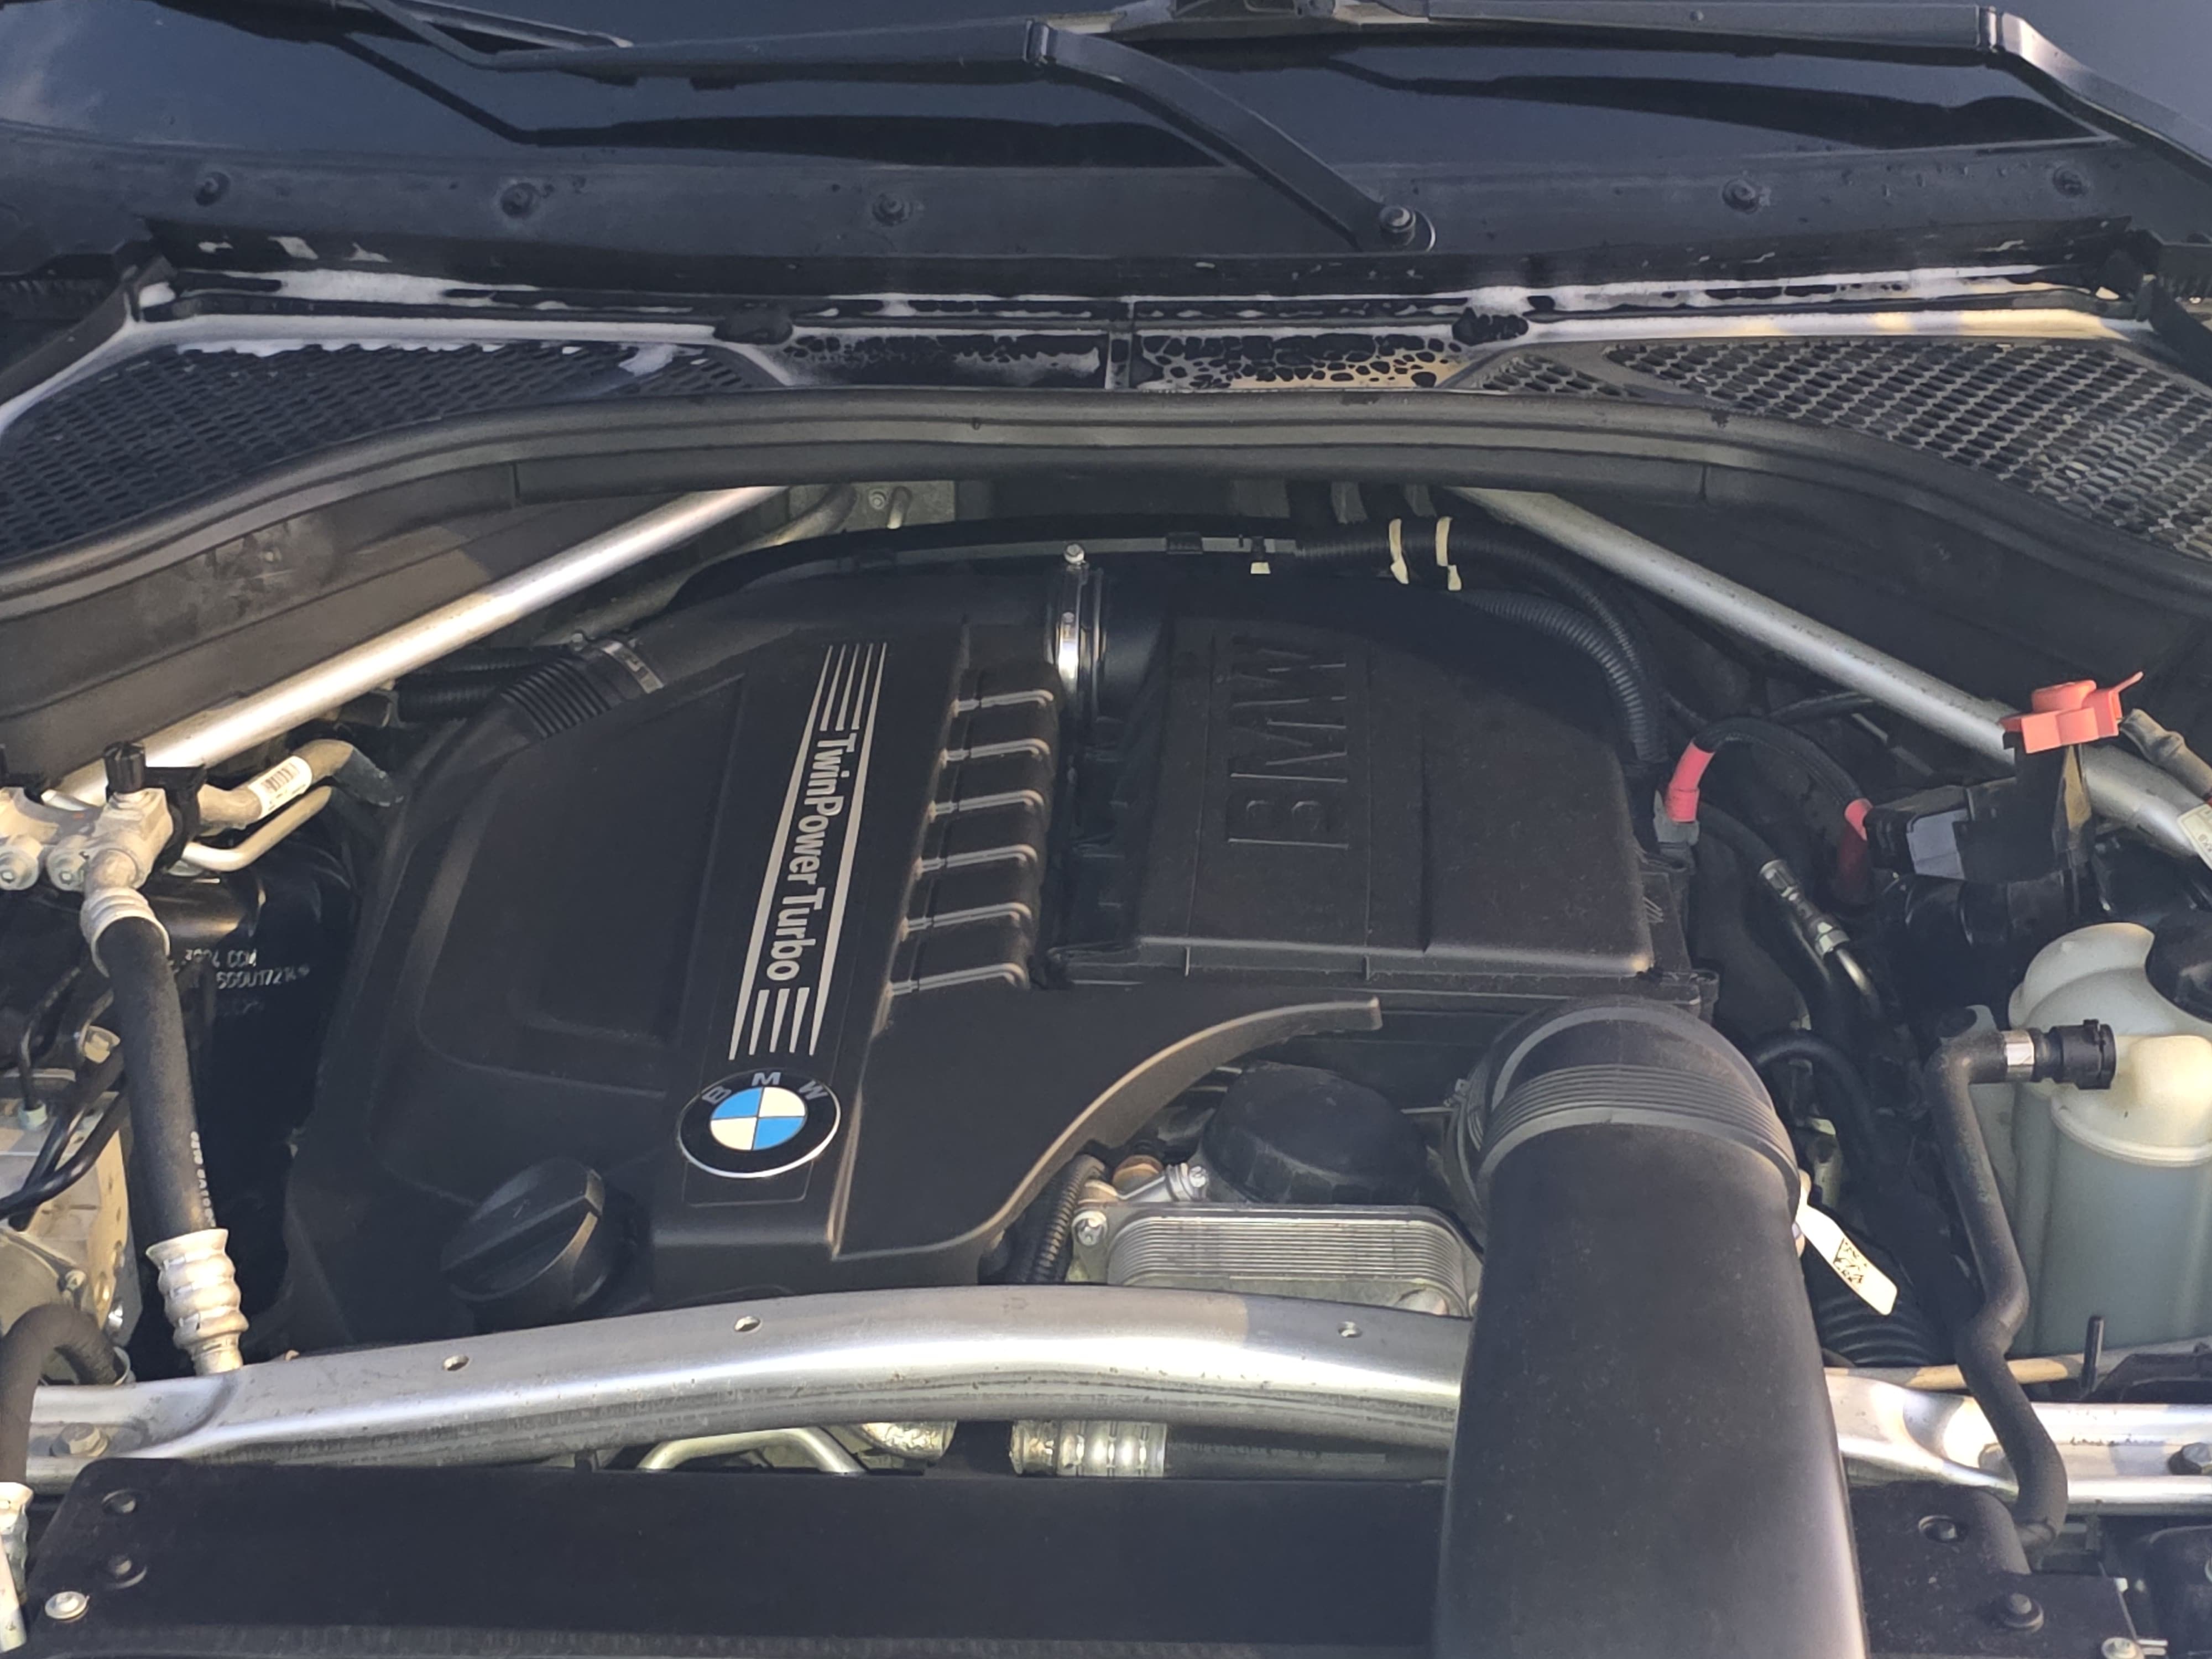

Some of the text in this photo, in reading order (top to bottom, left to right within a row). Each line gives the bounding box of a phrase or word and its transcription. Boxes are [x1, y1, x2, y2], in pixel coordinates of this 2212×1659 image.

[1227, 634, 1350, 851] BMW
[766, 732, 858, 981] TwinPower Turbo
[701, 1071, 829, 1105] BMW
